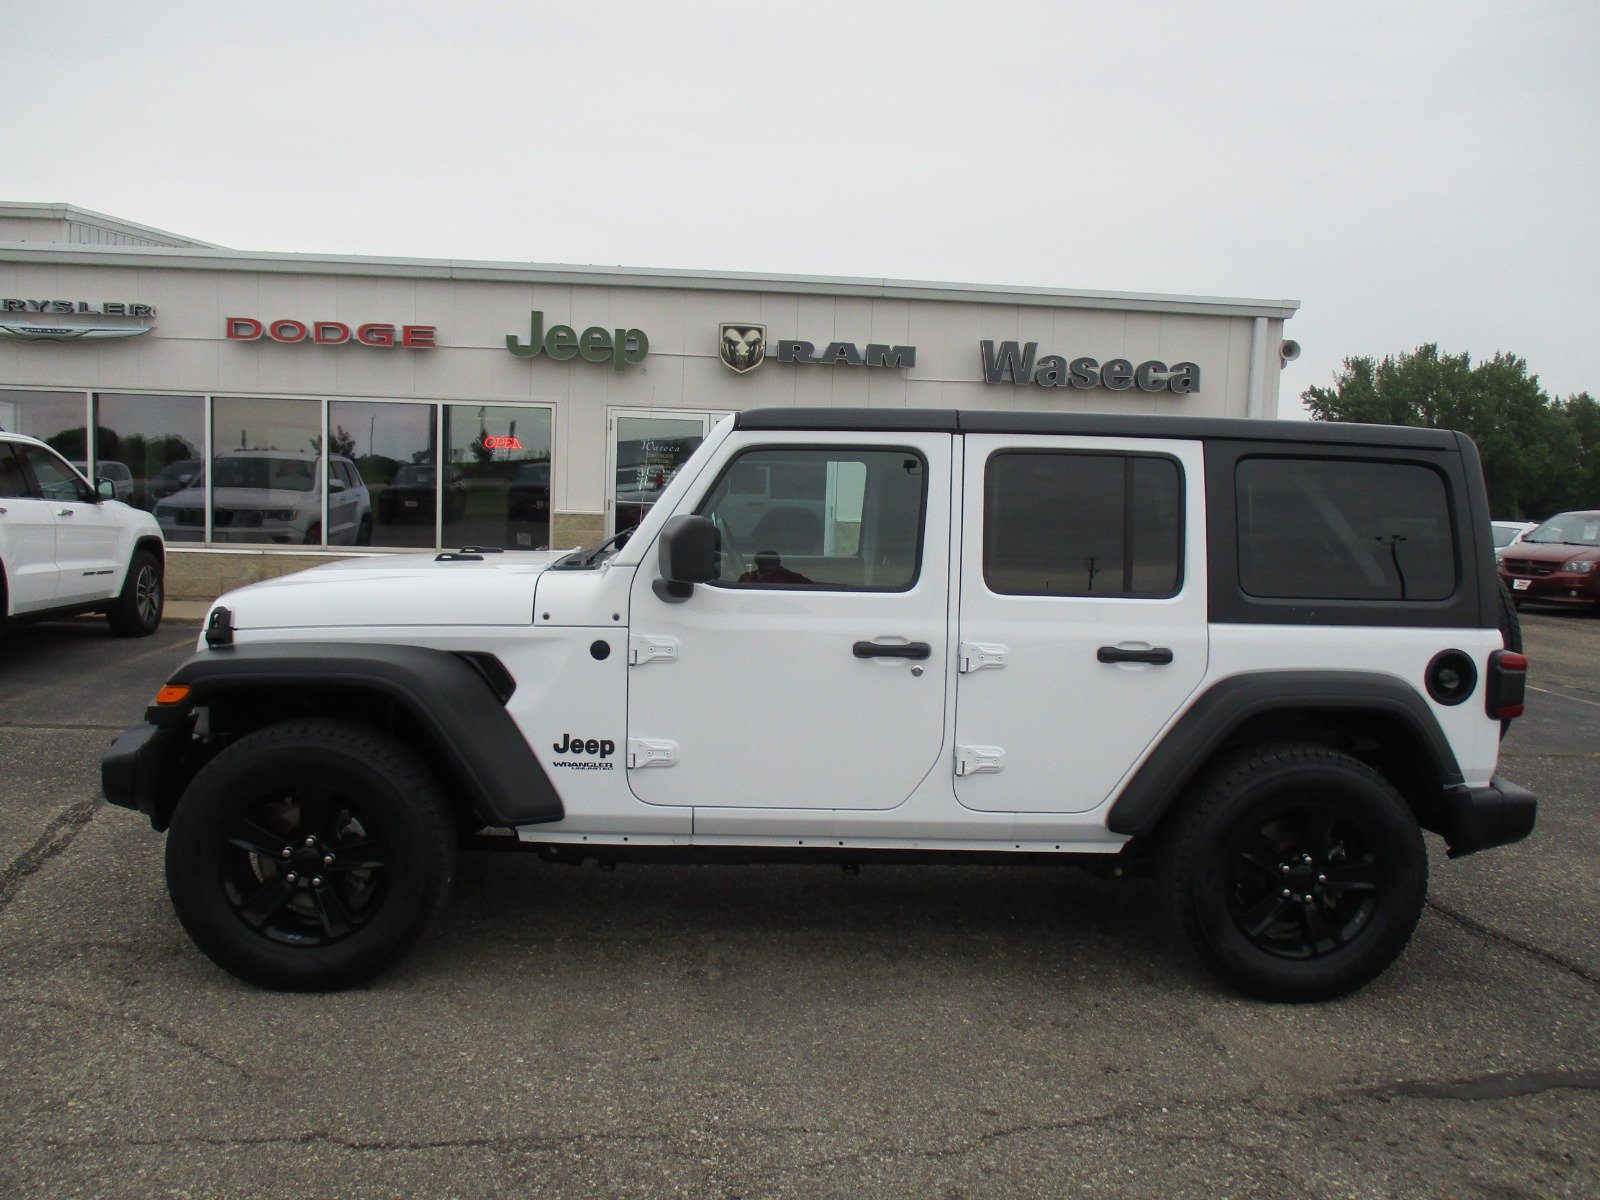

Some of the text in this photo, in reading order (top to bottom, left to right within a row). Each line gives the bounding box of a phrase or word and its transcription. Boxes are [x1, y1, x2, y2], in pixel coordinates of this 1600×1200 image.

[226, 316, 437, 348] DODGE
[505, 310, 649, 373] Jeep
[777, 339, 916, 368] RAM
[980, 339, 1201, 394] Waseca
[553, 733, 615, 758] Jeep
